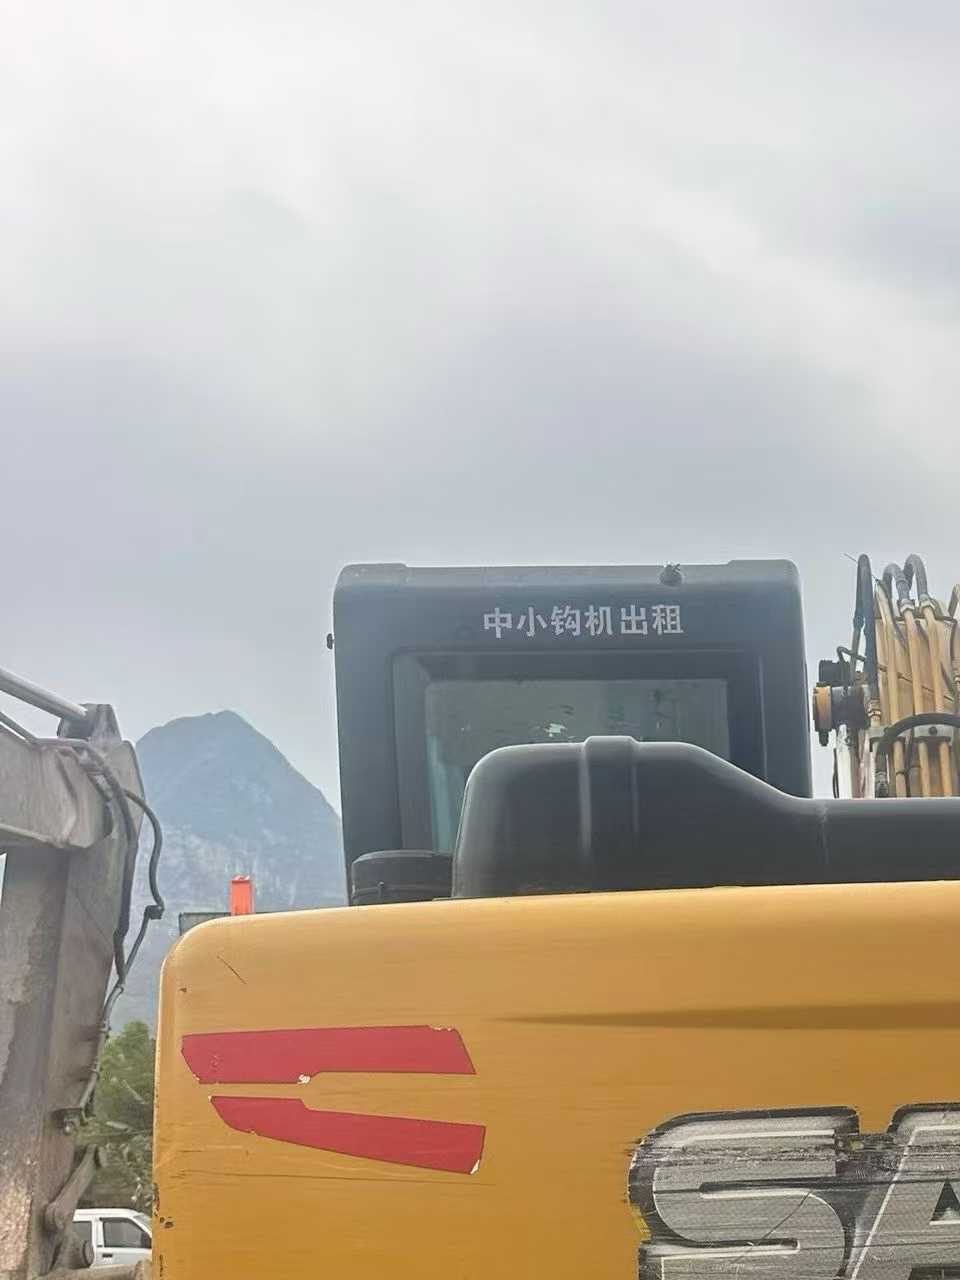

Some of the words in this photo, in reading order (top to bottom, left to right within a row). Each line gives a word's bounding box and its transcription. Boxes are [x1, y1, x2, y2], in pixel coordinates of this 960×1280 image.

[483, 604, 684, 639] 中小钩机出租
